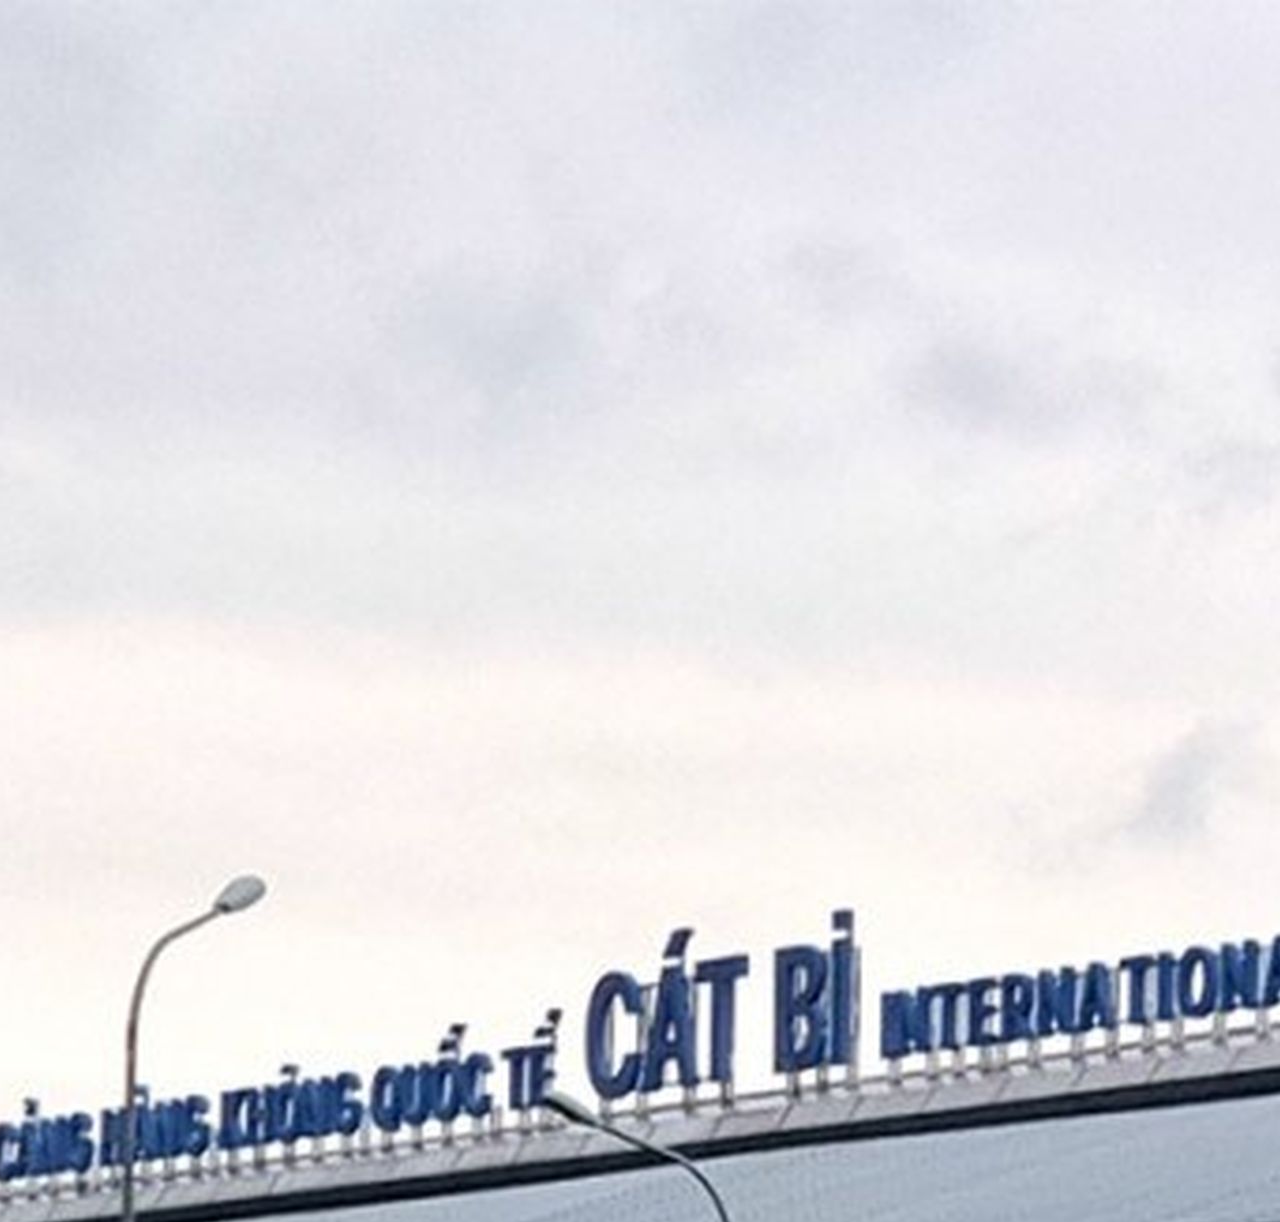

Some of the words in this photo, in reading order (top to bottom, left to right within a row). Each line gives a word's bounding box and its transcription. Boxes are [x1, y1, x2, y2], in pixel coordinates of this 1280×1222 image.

[371, 1023, 495, 1132] QUỐC
[501, 1008, 563, 1110] TẾ
[586, 927, 749, 1099] CÁT
